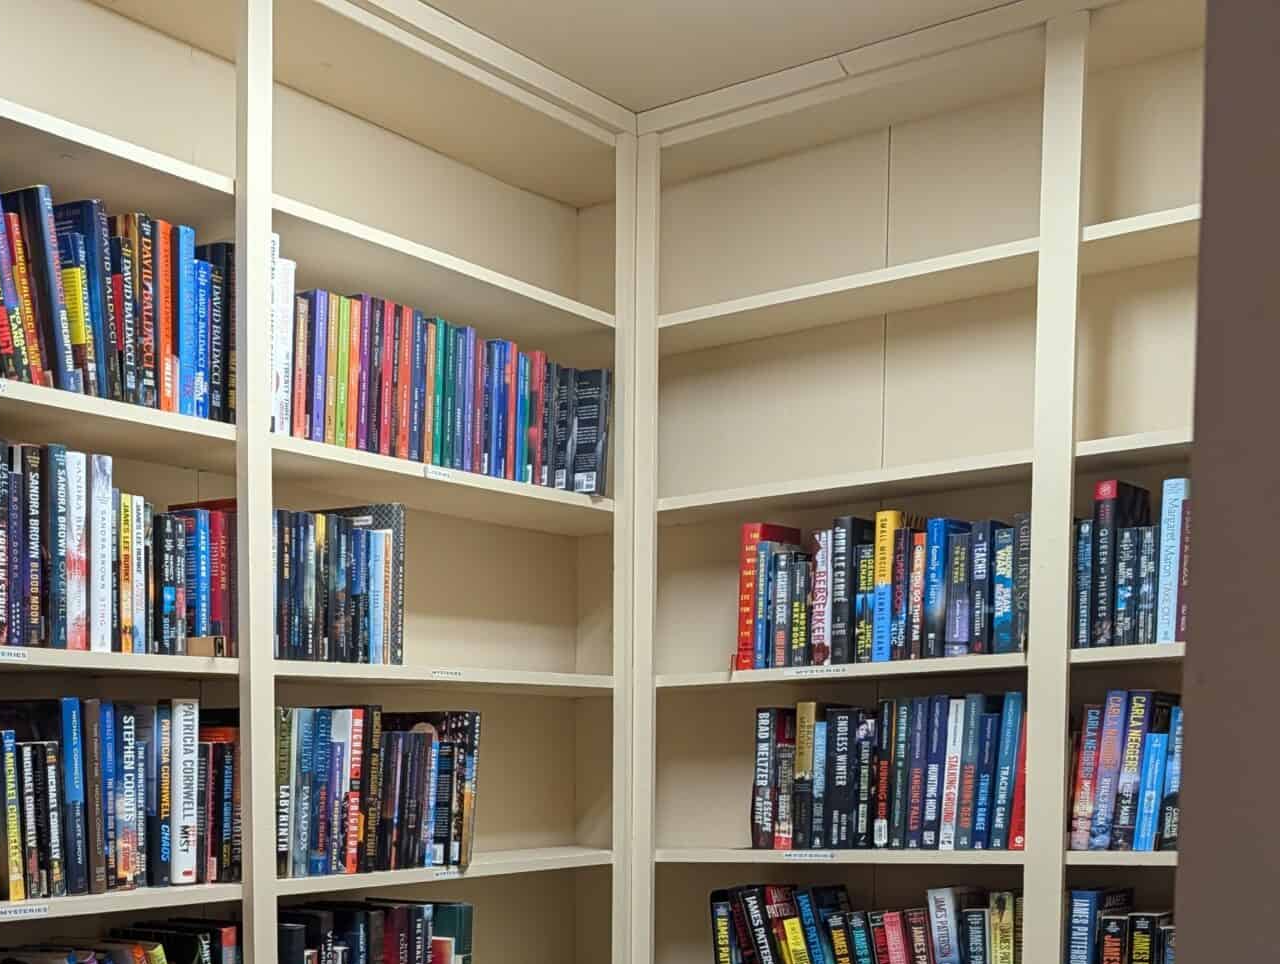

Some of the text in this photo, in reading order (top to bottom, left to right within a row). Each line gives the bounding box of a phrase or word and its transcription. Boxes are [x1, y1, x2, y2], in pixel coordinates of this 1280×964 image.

[59, 310, 74, 372] REDEMPTION
[212, 285, 222, 385] DAVID BALDACCI
[30, 472, 40, 624] SANDRA BROWN BLOOD MOON
[834, 527, 846, 554] JOHN
[834, 557, 846, 568] LE
[974, 543, 986, 580] TEACHER
[1098, 529, 1108, 563] QUEEN
[813, 571, 827, 643] BERSERKER
[757, 712, 769, 786] BRAD MELTZER
[835, 716, 848, 786] ENDLESS WINTER
[1124, 695, 1146, 773] CARLA NEGGERS
[123, 715, 135, 821] STEPHEN COONTS
[180, 704, 194, 853] PATRICIA CORNWELL MIST
[278, 785, 289, 851] LABYRINTH
[301, 785, 310, 850] PARADOX
[0, 906, 47, 916] MYSTERIES
[746, 896, 765, 926] JAMES
[1131, 931, 1148, 960] JAMES
